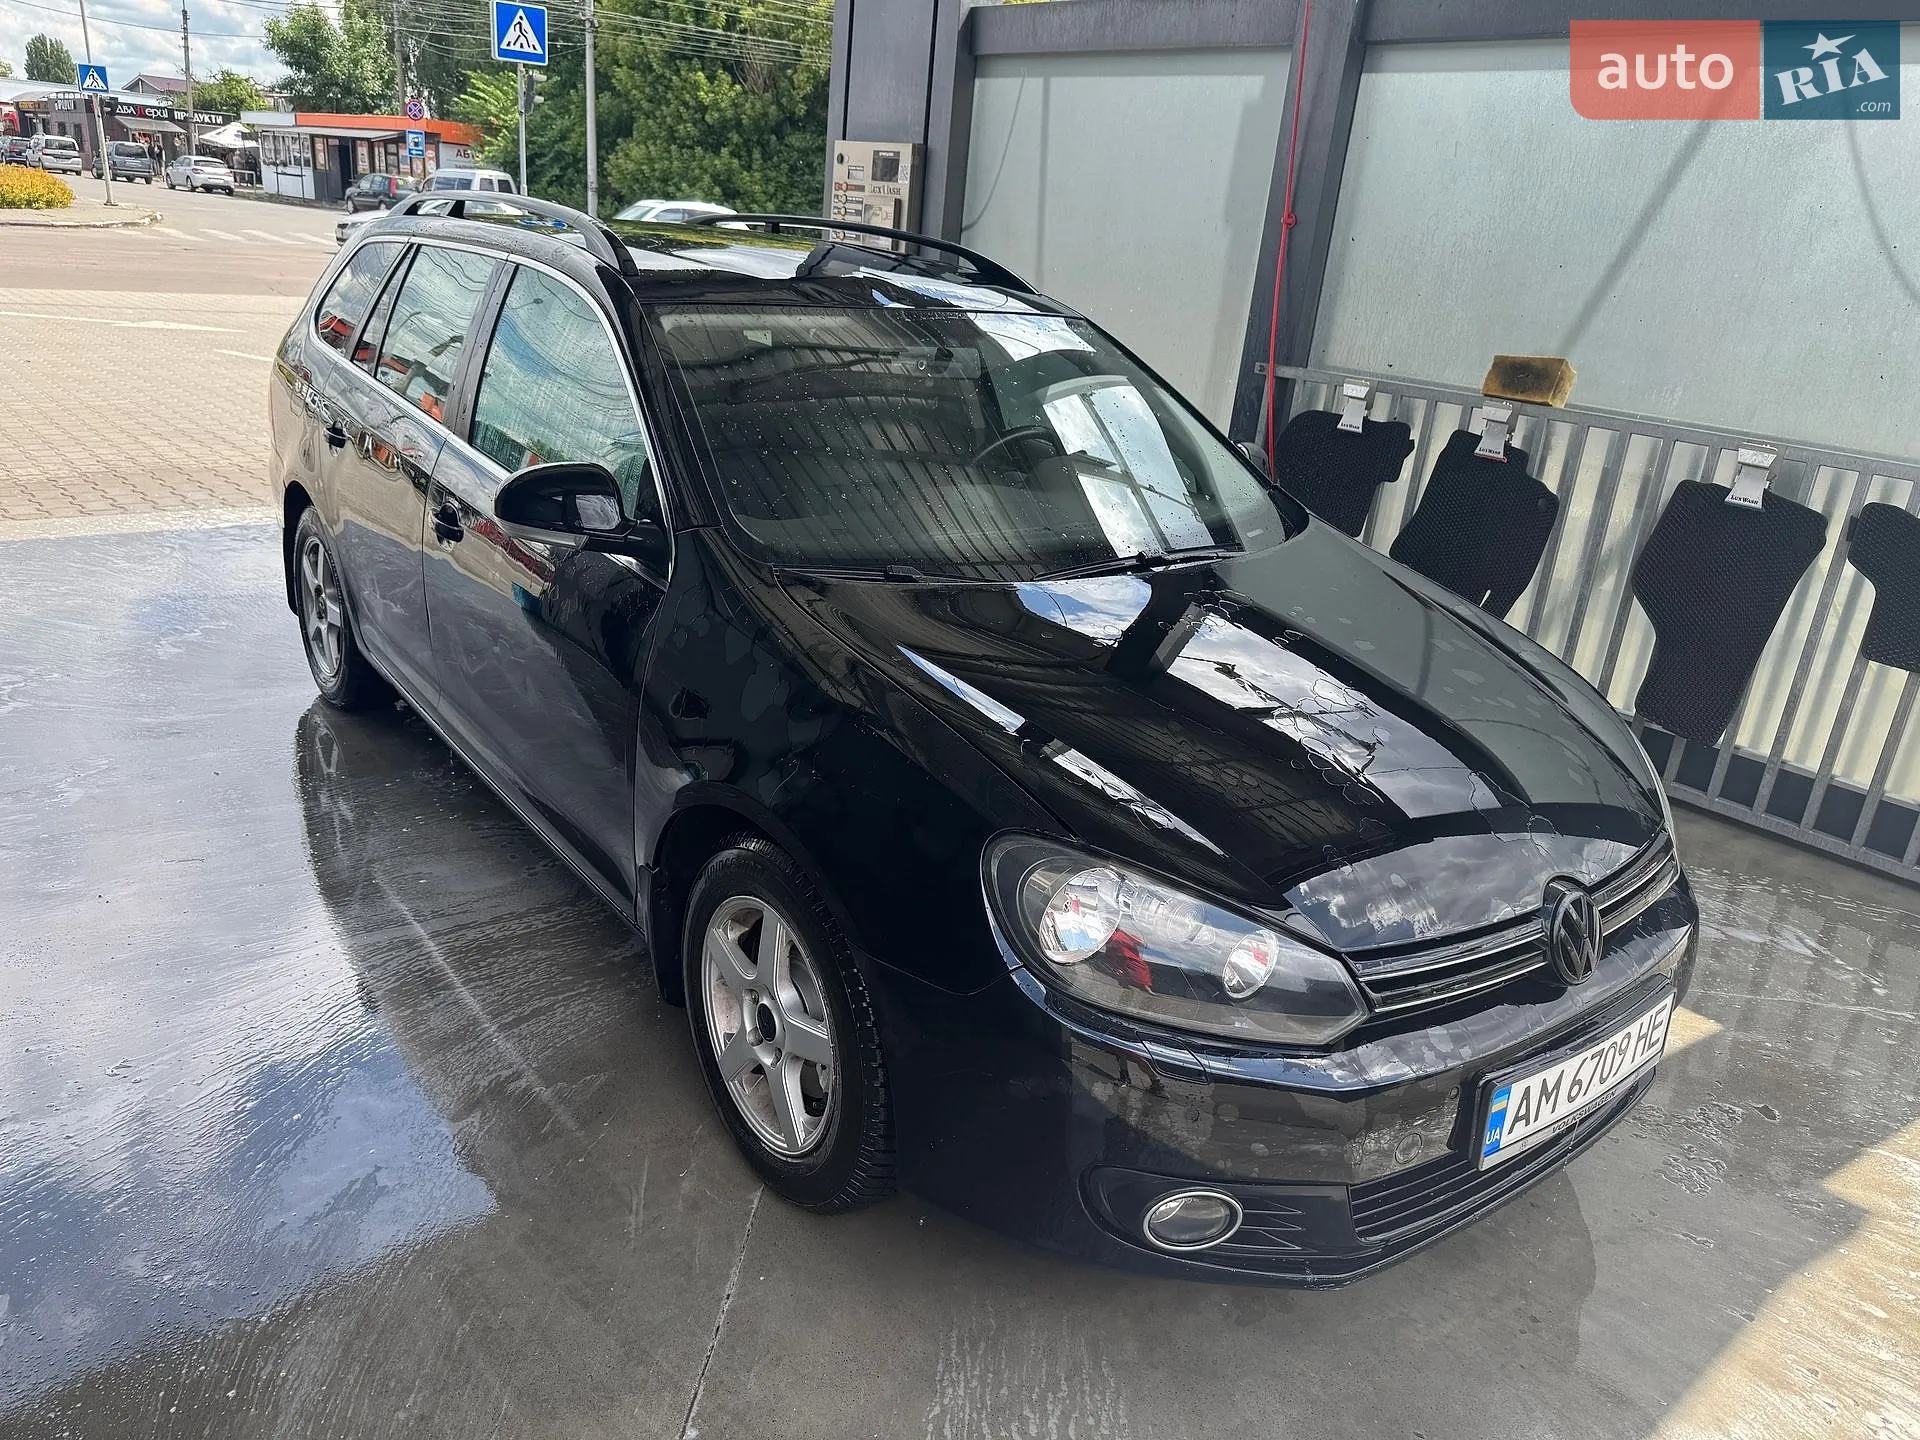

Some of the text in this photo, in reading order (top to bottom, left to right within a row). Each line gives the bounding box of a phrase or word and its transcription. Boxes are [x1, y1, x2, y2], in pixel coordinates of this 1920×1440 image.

[1508, 1003, 1668, 1136] AM 6709 HE
[1552, 1090, 1617, 1134] VOLKSWAGEN
[1486, 1128, 1501, 1146] UA
